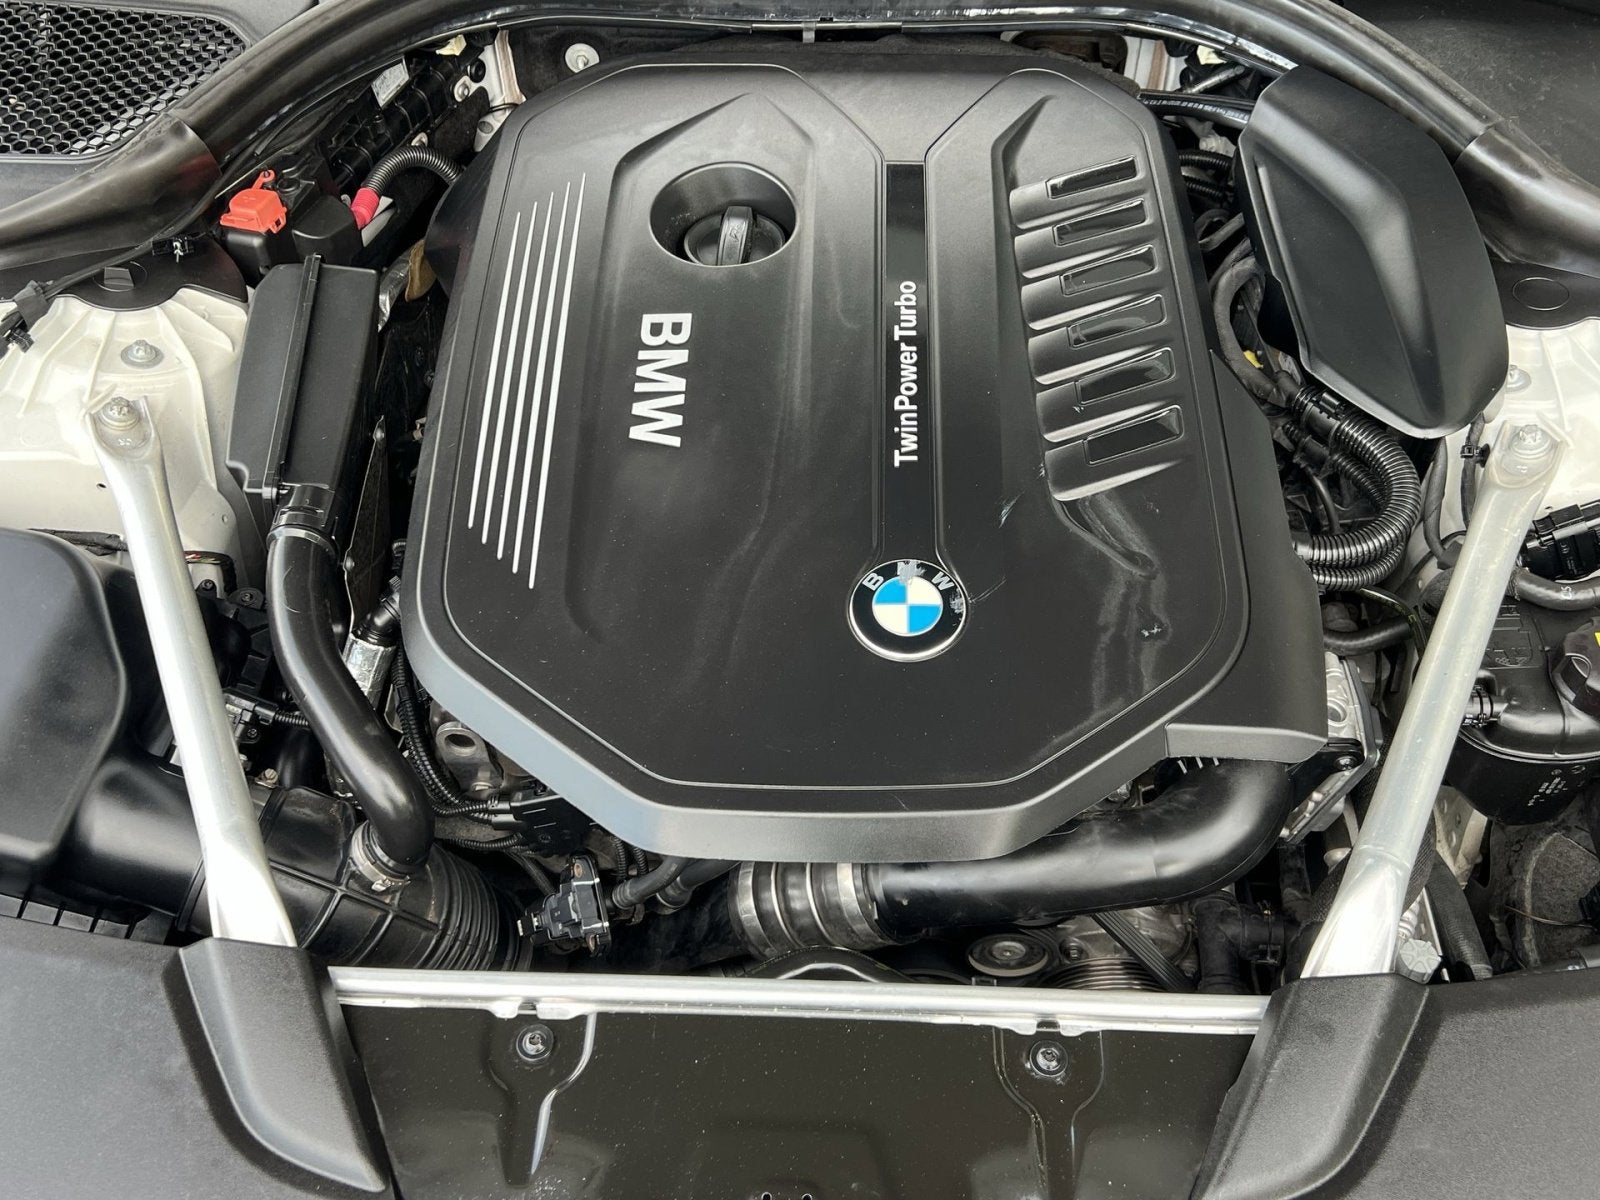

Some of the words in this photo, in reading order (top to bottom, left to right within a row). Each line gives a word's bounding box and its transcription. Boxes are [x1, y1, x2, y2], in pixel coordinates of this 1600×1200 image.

[894, 281, 917, 341] Turbo
[628, 312, 692, 447] BMW
[894, 342, 918, 467] TwinPower
